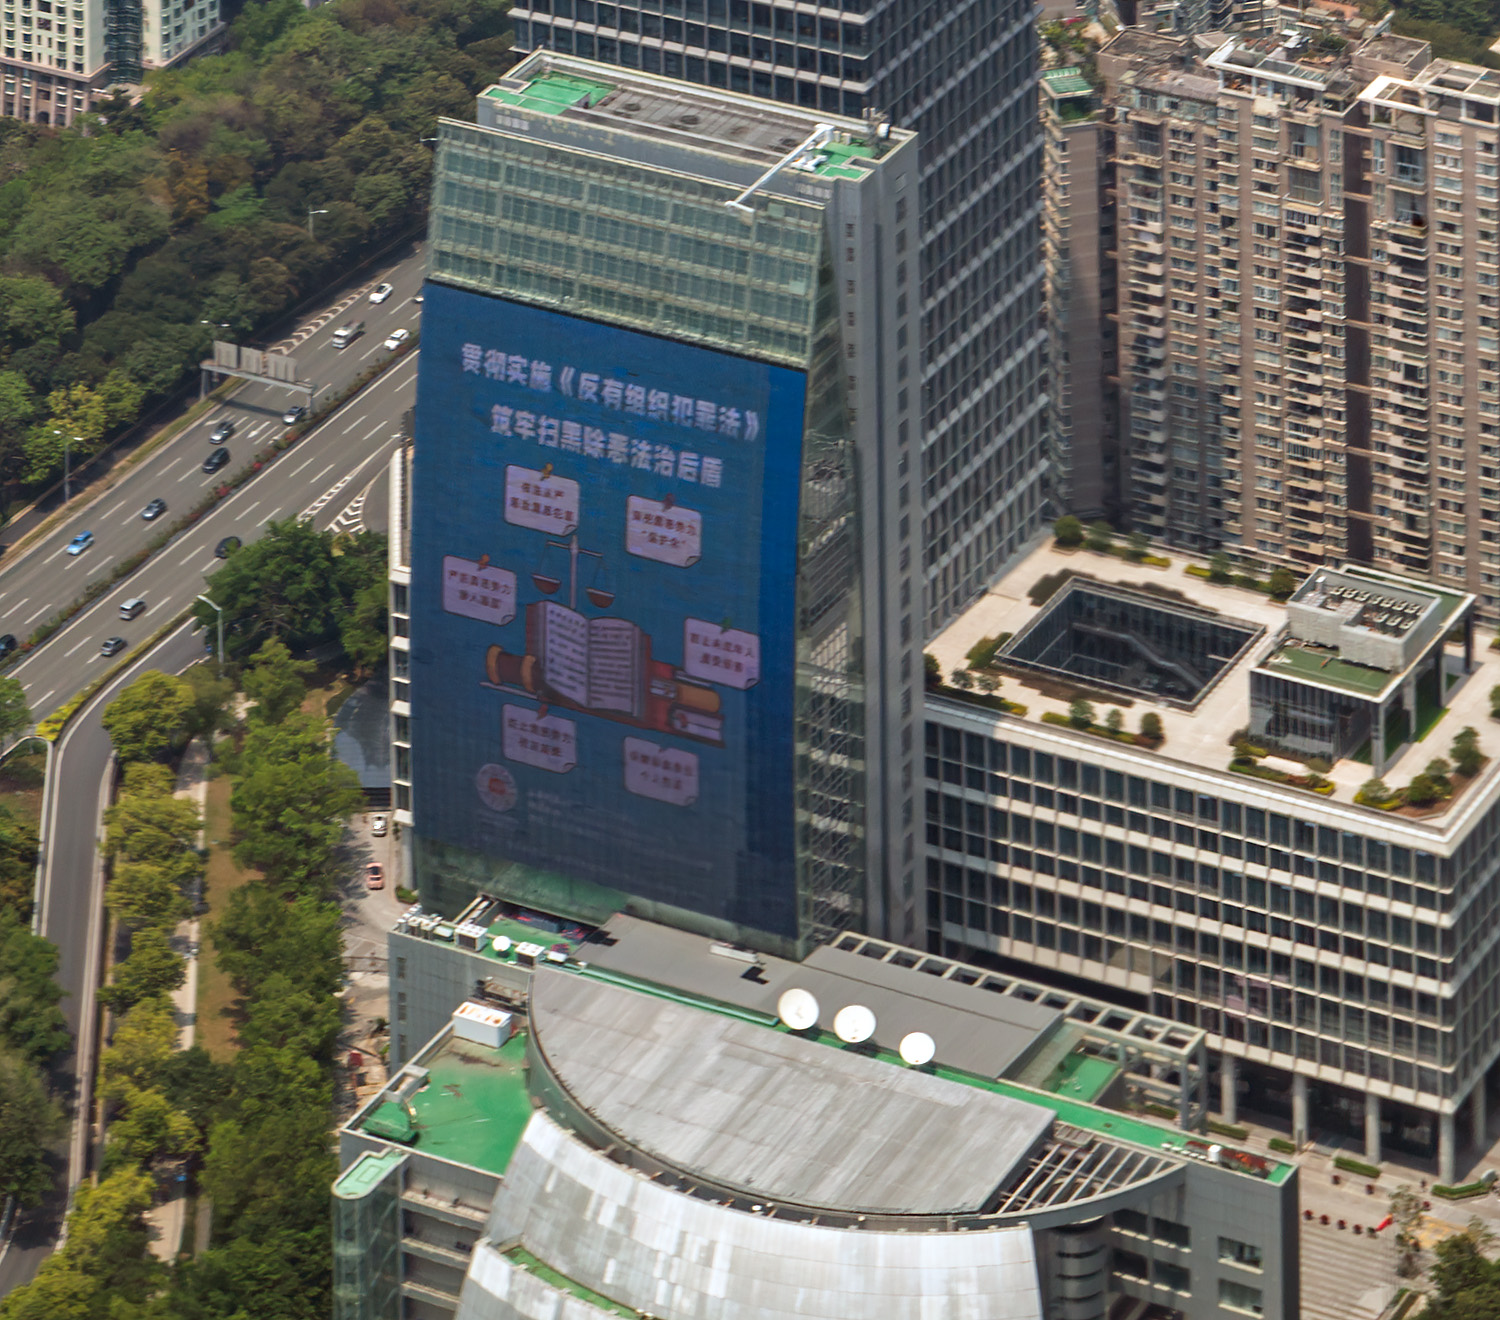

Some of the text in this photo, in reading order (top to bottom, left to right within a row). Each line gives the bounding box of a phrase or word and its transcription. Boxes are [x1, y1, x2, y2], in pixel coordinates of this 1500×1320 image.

[461, 343, 760, 441] 贯彻实施《反有组织犯罪法》
[490, 404, 724, 489] 筑牢扫黑除恶法治后盾
